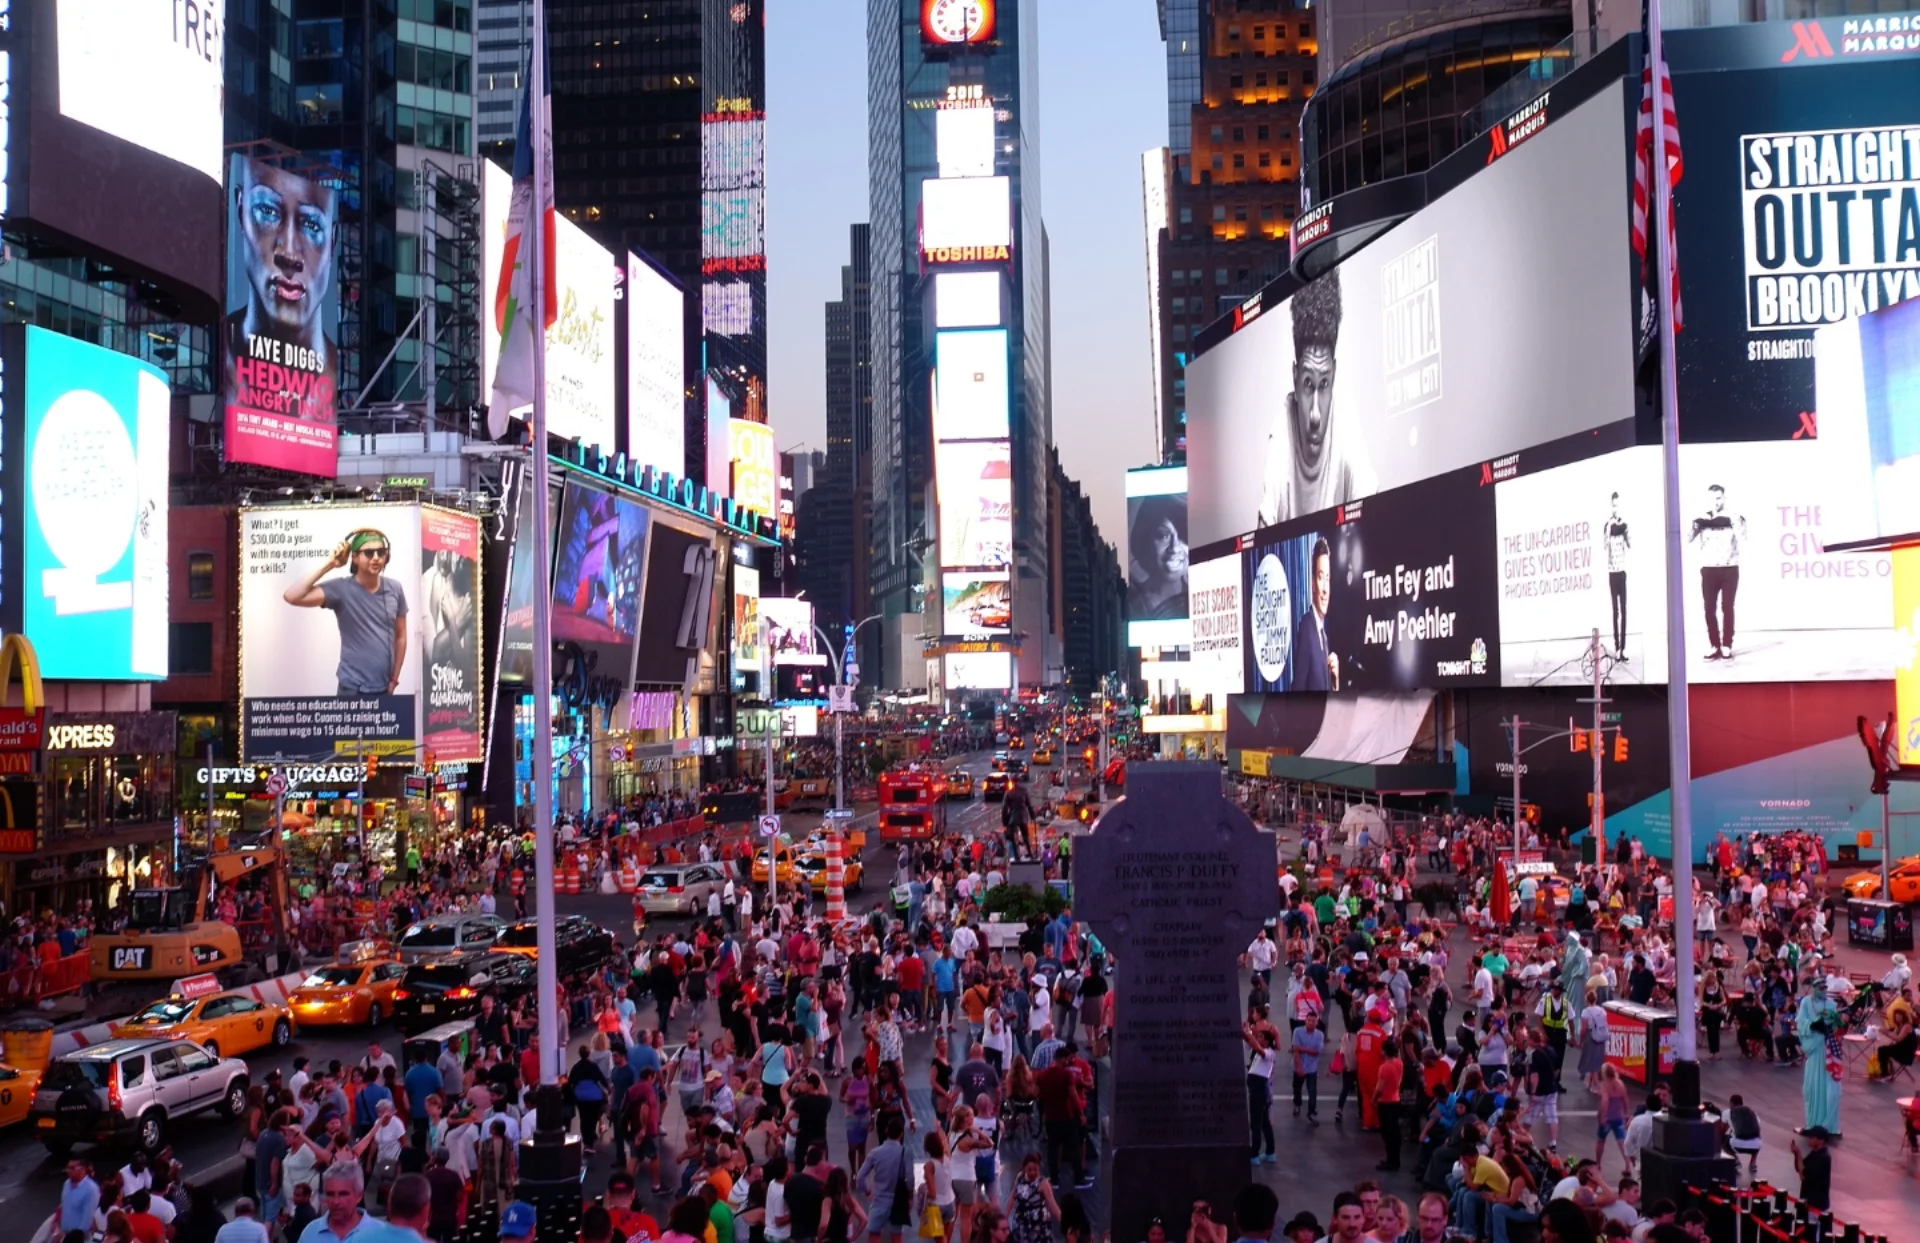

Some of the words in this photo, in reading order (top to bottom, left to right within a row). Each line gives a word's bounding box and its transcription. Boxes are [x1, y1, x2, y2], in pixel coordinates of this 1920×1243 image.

[1845, 33, 1920, 53] MARQU
[947, 85, 984, 100] 2015
[939, 98, 993, 110] TOSHIBA
[1509, 91, 1550, 130] MARRIOTT
[1509, 112, 1545, 146] MARQUIS
[1750, 131, 1920, 188] STRAIGHT
[1296, 201, 1334, 231] MARRIOTT
[1297, 219, 1329, 246] MARQUIS
[1754, 187, 1920, 269] OUTTA
[924, 245, 1009, 262] TOSHIBA
[248, 333, 280, 363] TAYE
[285, 343, 325, 373] DIGGS
[237, 355, 333, 404] HEDWIG
[237, 387, 293, 414] ANGRY
[297, 400, 333, 420] INCH
[1493, 454, 1520, 469] MARRIOTT
[578, 440, 643, 487] 1540
[651, 465, 760, 533] BROADWAY
[251, 519, 278, 530] What?
[280, 520, 283, 529] I
[284, 519, 299, 531] get
[250, 533, 286, 545] $30,000
[287, 536, 293, 544] a
[294, 535, 313, 546] year
[1504, 534, 1522, 555] THE
[1524, 521, 1590, 552] UN-CARRIER
[251, 548, 269, 559] with
[270, 550, 281, 559] no
[282, 548, 329, 561] experience
[1504, 555, 1536, 580] GIVES
[1538, 551, 1562, 574] YOU
[1564, 546, 1591, 571] NEW
[250, 565, 259, 574] or
[261, 563, 287, 574] skills?
[1362, 570, 1393, 601] Tina
[1395, 564, 1421, 602] Fey
[1425, 554, 1454, 592] and
[1781, 559, 1869, 579] PHONES
[1876, 559, 1892, 577] O
[1256, 573, 1268, 593] THE
[1505, 580, 1538, 599] PHONES
[1539, 579, 1552, 596] ON
[1553, 573, 1592, 594] DEMAND
[1192, 590, 1210, 615] BEST
[1212, 585, 1238, 613] SCORE!
[1256, 588, 1286, 610] TONIGHT
[1213, 613, 1239, 636] LAUPER
[1256, 609, 1278, 629] SHOW
[1364, 614, 1395, 651] Amy
[1398, 605, 1456, 642] Poehler
[1206, 639, 1219, 650] TONY
[1220, 636, 1239, 649] AWARD
[1264, 627, 1287, 647] JIMMY
[1260, 647, 1288, 665] FALLON
[1437, 660, 1471, 676] TONIGHT
[1471, 661, 1487, 675] NBC
[251, 701, 270, 711] Who
[271, 700, 295, 711] needs
[297, 702, 307, 710] an
[308, 700, 349, 711] education
[350, 701, 358, 710] or
[359, 699, 379, 710] hard
[251, 714, 271, 724] work
[273, 713, 294, 723] when
[296, 713, 312, 723] Gov.
[314, 712, 342, 723] Cuomo
[343, 712, 351, 722] is
[352, 712, 380, 725] raising
[382, 711, 396, 722] the
[251, 727, 288, 737] minimum
[289, 727, 311, 738] wage
[313, 726, 321, 736] to
[324, 725, 334, 736] 15
[335, 725, 363, 736] dollars
[364, 726, 375, 735] an
[377, 723, 400, 735] hour?
[197, 767, 256, 784] GIFTS
[1495, 762, 1528, 775] VORNDO
[1760, 799, 1811, 808] VORNADO
[1121, 852, 1178, 862] LIEUTENANT
[1183, 851, 1229, 862] COLONEL
[1115, 865, 1172, 879] FRANCIS
[1177, 865, 1185, 878] P
[1191, 864, 1239, 878] DUFFY
[1131, 898, 1181, 907] CATHOLIC
[1186, 897, 1223, 907] PRIEST
[1153, 922, 1202, 932] CHAPLAIN
[114, 948, 145, 969] CAT
[1129, 994, 1154, 1004] GOD
[1156, 994, 1178, 1003] AND
[1181, 993, 1230, 1004] COUNTRY
